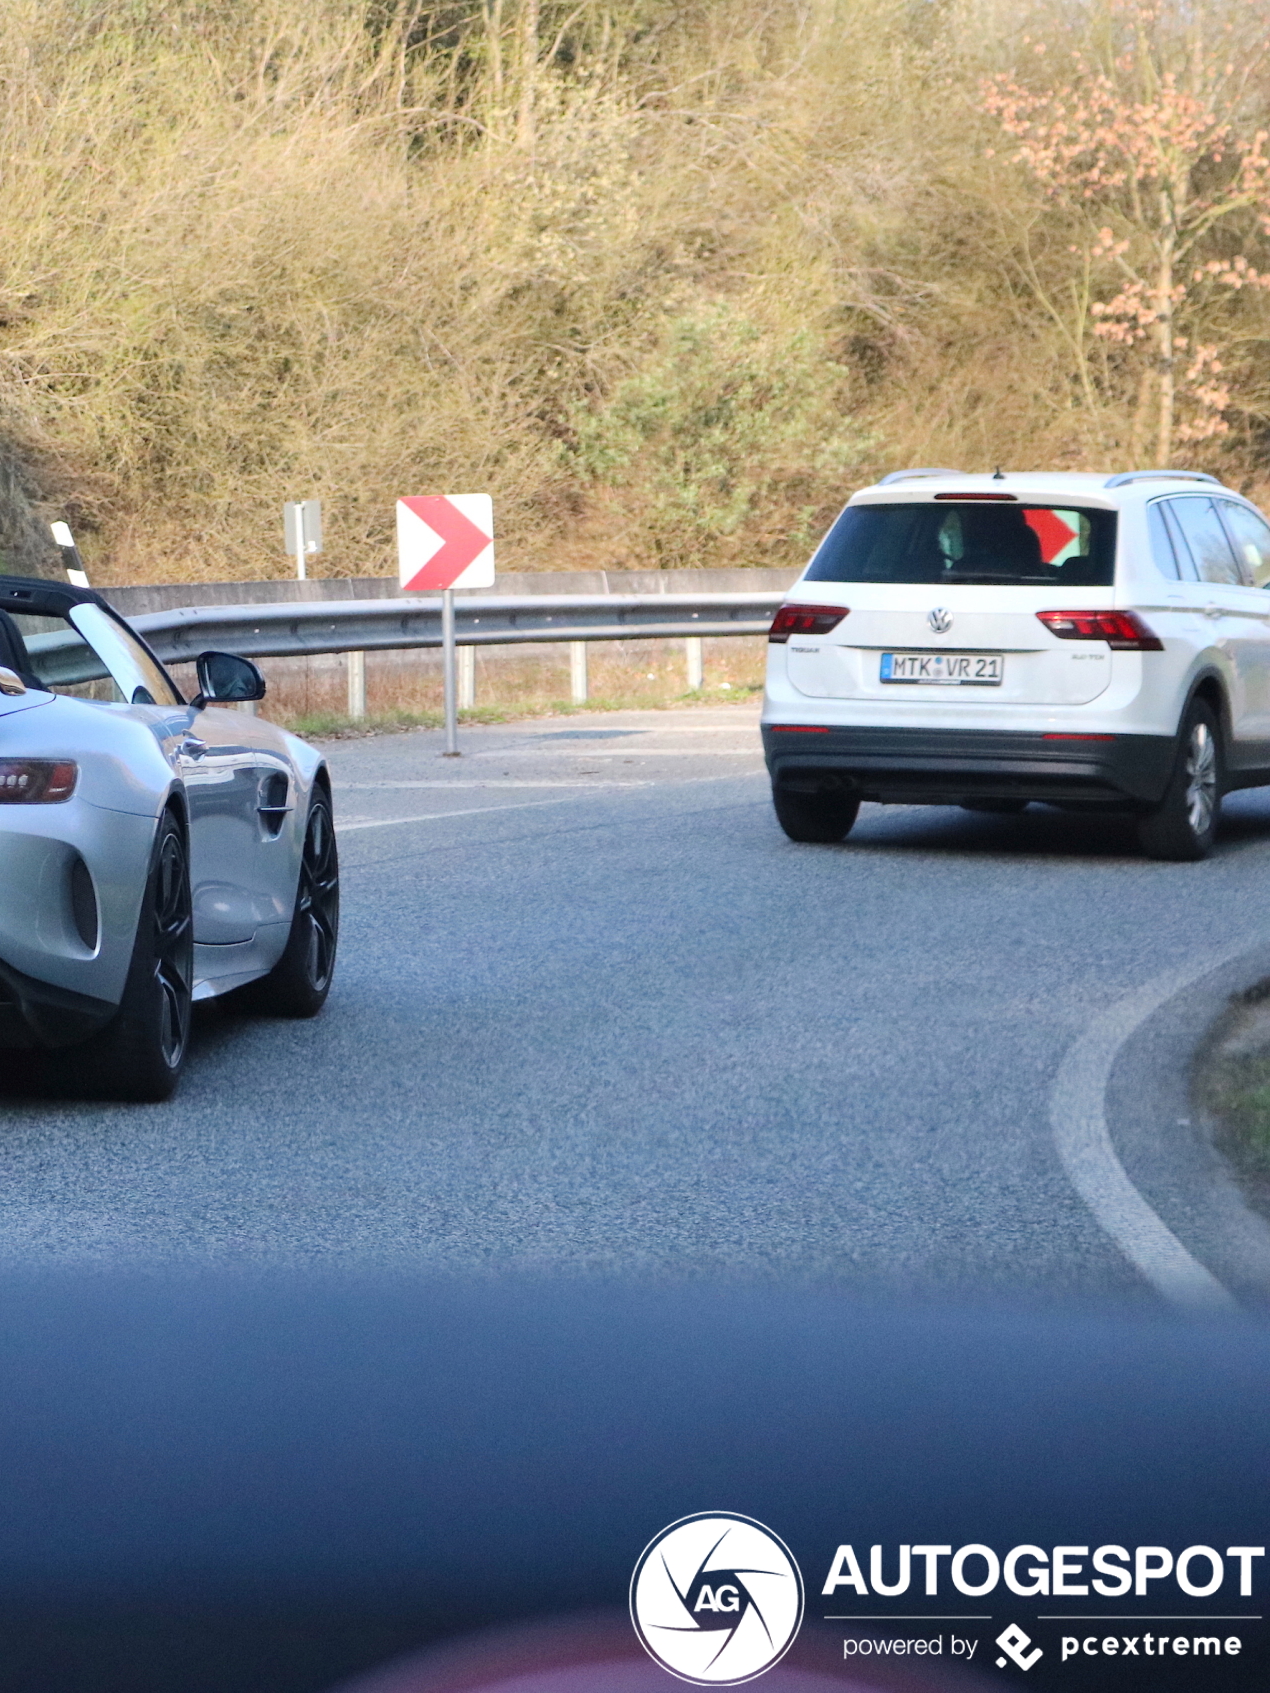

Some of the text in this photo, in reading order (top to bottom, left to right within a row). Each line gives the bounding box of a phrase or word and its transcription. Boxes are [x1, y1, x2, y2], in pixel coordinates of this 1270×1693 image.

[893, 657, 998, 678] MTK VR 21
